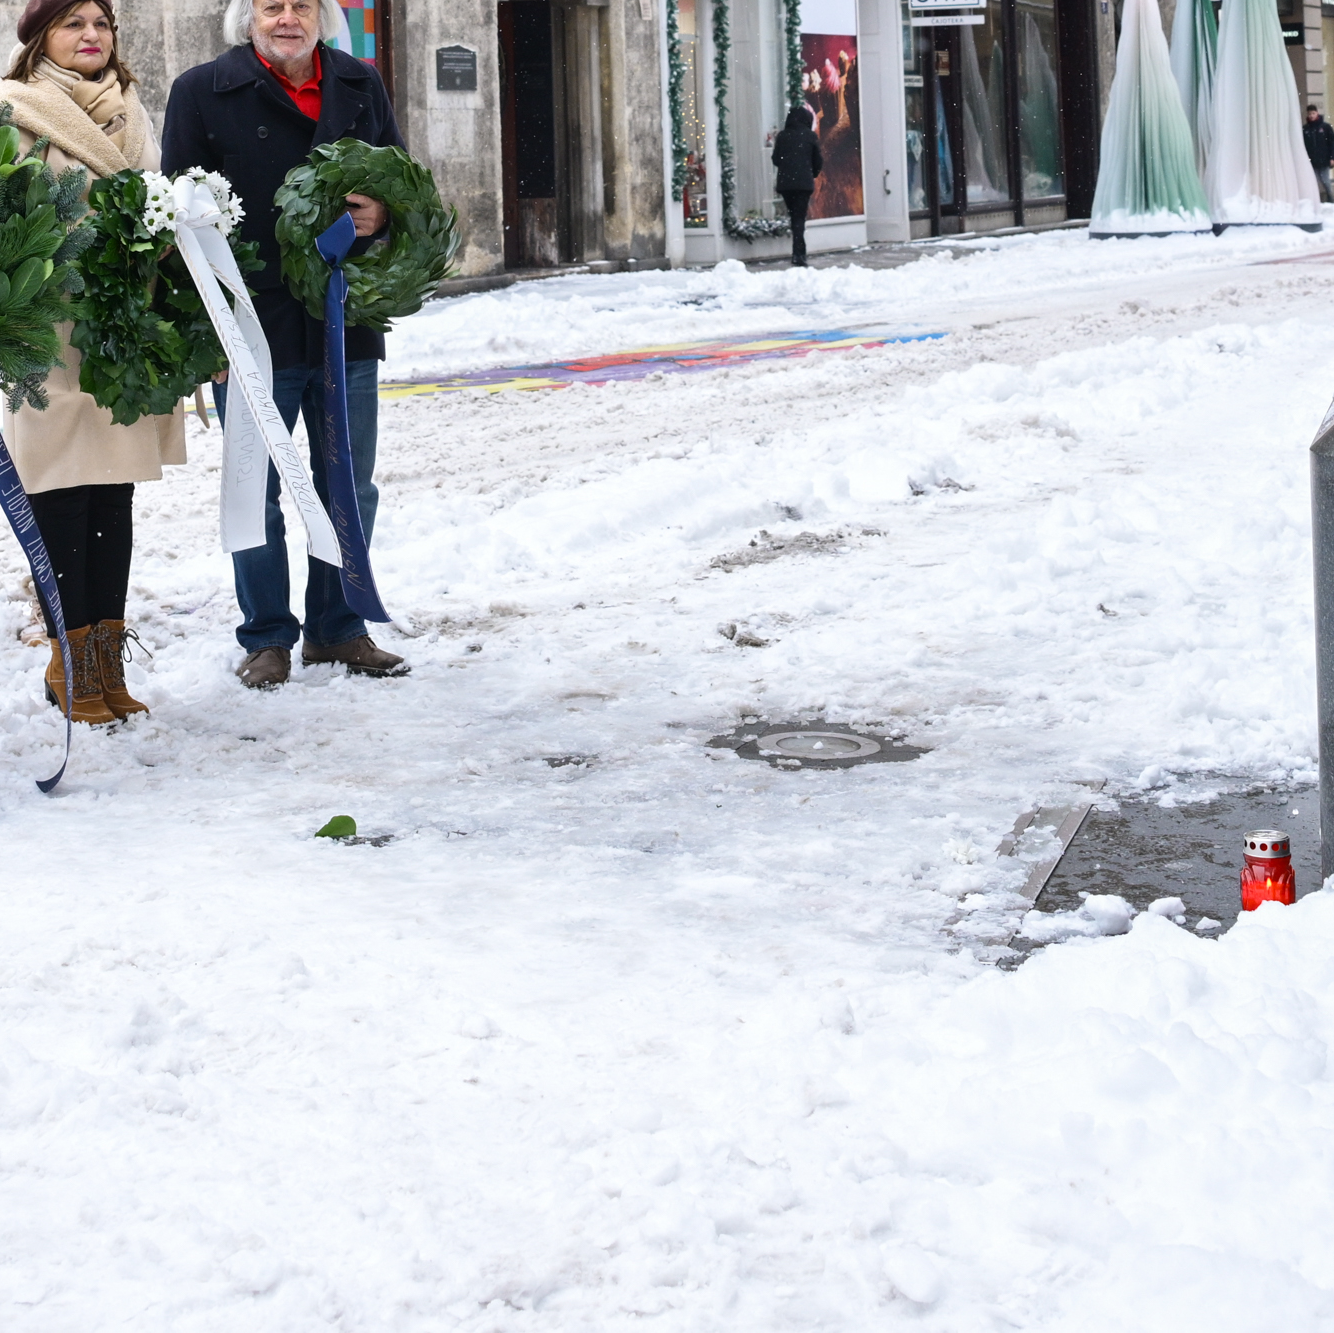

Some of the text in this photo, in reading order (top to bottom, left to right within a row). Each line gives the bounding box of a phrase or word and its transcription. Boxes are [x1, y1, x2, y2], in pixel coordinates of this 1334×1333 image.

[220, 306, 319, 516] UDRUGA NIKOLA TESLA
[1, 479, 36, 535] NIKOLE
